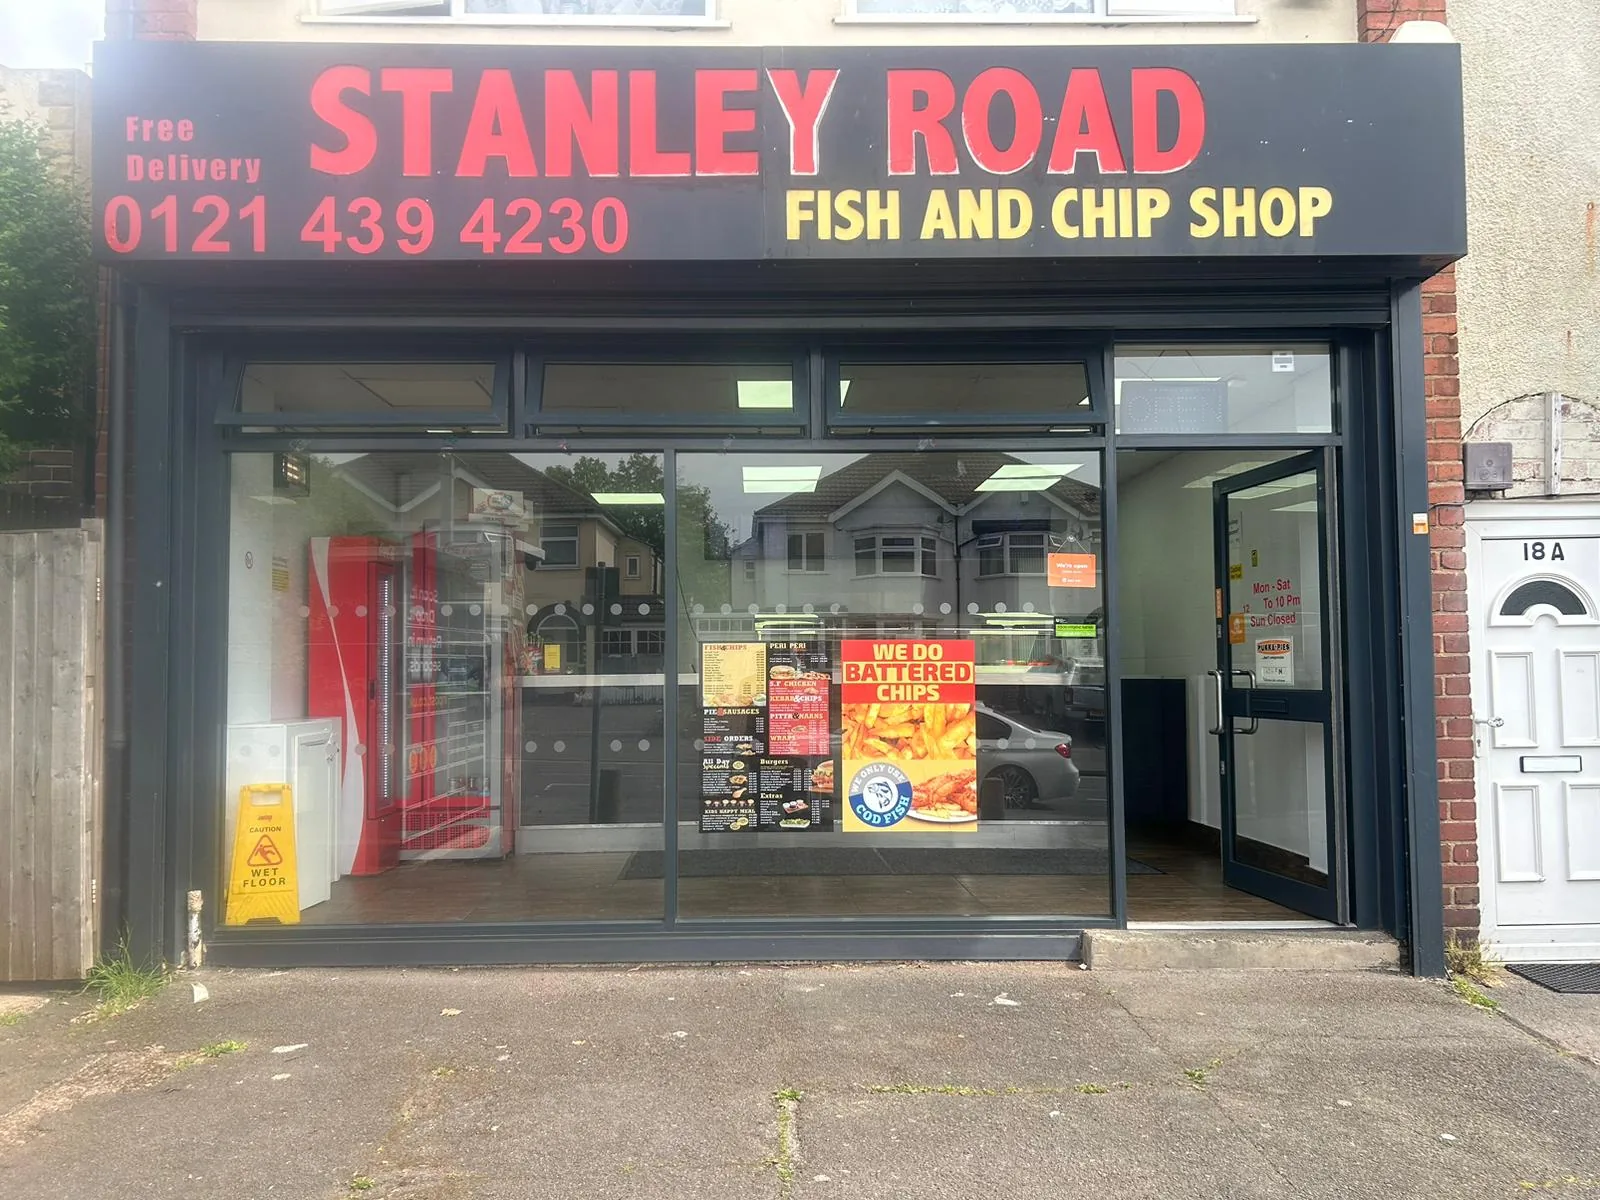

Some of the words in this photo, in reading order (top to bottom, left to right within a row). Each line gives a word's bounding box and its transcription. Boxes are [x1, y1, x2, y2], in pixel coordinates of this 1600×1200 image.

[126, 117, 193, 142] Free
[309, 66, 841, 178] STANLEY
[887, 67, 1206, 174] ROAD
[126, 155, 261, 184] Delivery
[786, 191, 901, 241] FISH
[921, 189, 1033, 240] AND
[1052, 189, 1170, 239] CHIP
[1190, 187, 1332, 237] SHOP
[104, 195, 267, 254] 0121
[300, 196, 436, 256] 439
[460, 196, 629, 255] 4230
[1253, 581, 1270, 594] Mon
[1276, 578, 1291, 591] Sat
[1242, 604, 1250, 613] 12
[1263, 597, 1273, 609] To
[1275, 595, 1284, 607] 10
[1286, 594, 1300, 606] Pm
[1250, 615, 1266, 627] Sun
[1267, 612, 1296, 625] Closed
[872, 643, 908, 661] WE
[912, 643, 943, 661] DO
[845, 663, 971, 682] BATTERED
[876, 684, 940, 702] CHIPS
[851, 776, 862, 793] WE
[860, 764, 886, 779] ONLY
[887, 765, 907, 783] USE
[855, 803, 881, 824] COD
[884, 795, 911, 824] FISH
[251, 867, 279, 877] WET
[243, 877, 286, 888] FLOOR
